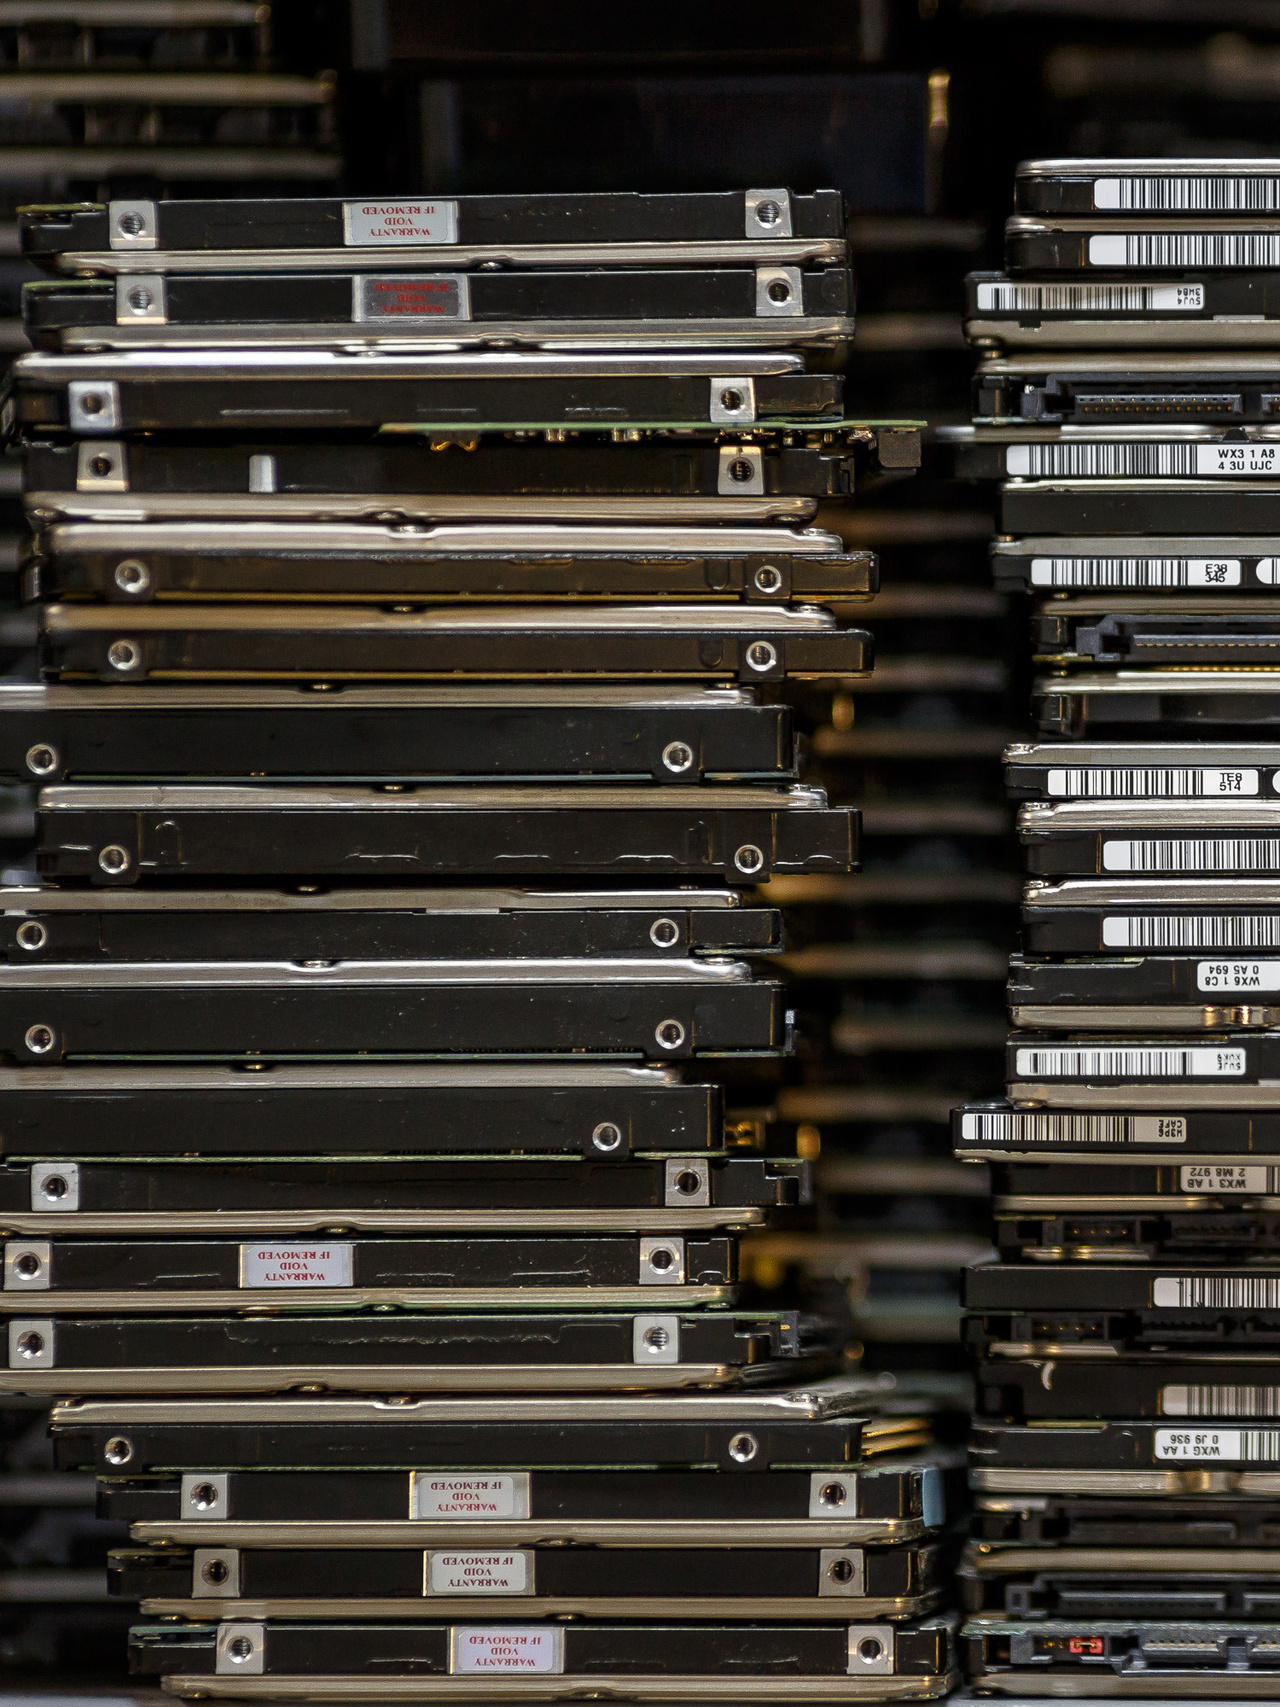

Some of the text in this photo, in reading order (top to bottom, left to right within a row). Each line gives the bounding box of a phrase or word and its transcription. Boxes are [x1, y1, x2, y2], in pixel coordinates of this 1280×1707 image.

[362, 206, 435, 215] IF REMOVED
[384, 217, 413, 225] VOID
[369, 228, 430, 236] WARRANTY
[374, 283, 449, 292] IF REMOVED
[396, 294, 426, 302] VOID
[1177, 297, 1201, 305] 5VJ4
[381, 305, 445, 313] WARRANTY
[1218, 449, 1275, 459] WX3 1 A8
[1218, 461, 1272, 470] 4 3U UJC
[1205, 564, 1227, 574] E38
[1205, 572, 1225, 583] 345
[1220, 773, 1242, 782] TE8
[1220, 782, 1241, 791] 514
[1209, 965, 1229, 974] 694
[1233, 965, 1248, 974] A5
[1205, 976, 1260, 986] WX6 1 C8
[1159, 1120, 1182, 1128] CAFE
[1158, 1128, 1182, 1137] W3P6
[1189, 1168, 1246, 1177] 2 M8 972
[1187, 1178, 1247, 1189] WX3 1 AB
[258, 1251, 330, 1259] IF REMOVED
[280, 1262, 308, 1270] VOID
[264, 1273, 325, 1281] WARRANTY
[1195, 1434, 1208, 1444] J9
[1162, 1446, 1220, 1456] WXG 1 AA
[431, 1482, 502, 1490] IF REMOVED
[452, 1492, 480, 1500] VOID
[436, 1503, 497, 1512] WARRANTY
[442, 1557, 514, 1565] IF REMOVED
[463, 1568, 492, 1576] VOID
[448, 1579, 508, 1587] WARRANTY
[469, 1636, 541, 1644] IF REMOVED
[491, 1647, 518, 1655] VOID
[474, 1658, 536, 1667] WARRANTY
